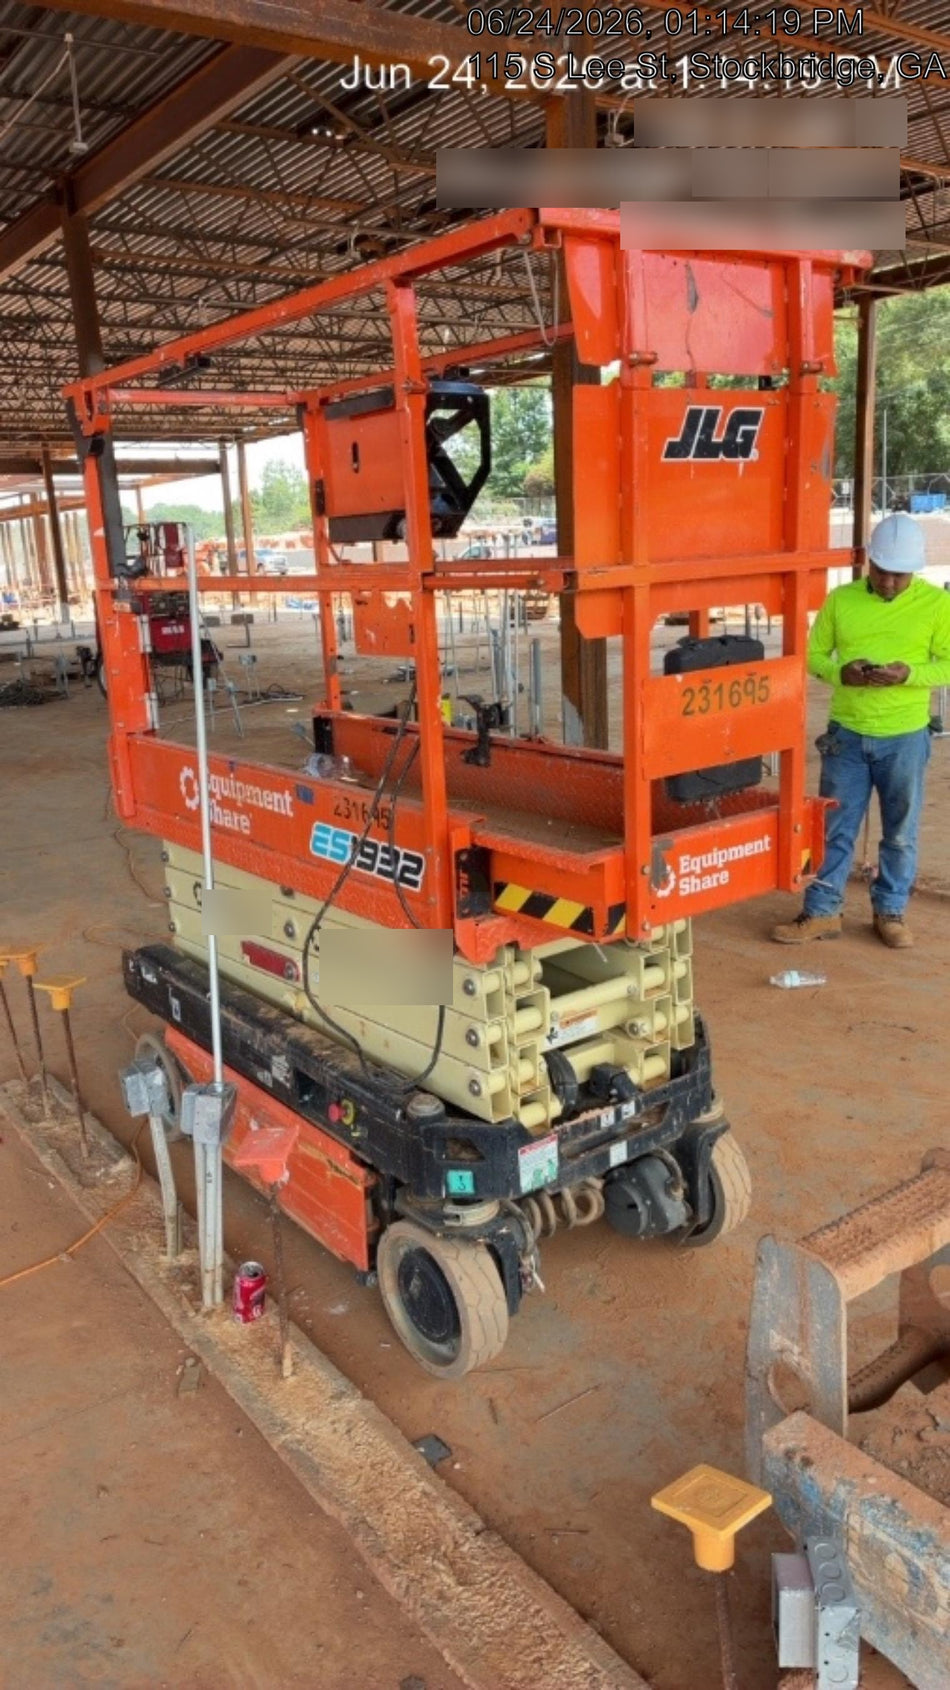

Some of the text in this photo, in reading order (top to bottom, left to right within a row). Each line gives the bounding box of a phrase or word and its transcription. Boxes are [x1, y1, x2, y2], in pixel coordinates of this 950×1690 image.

[661, 405, 765, 462] JLG
[681, 675, 770, 716] 231695
[208, 772, 294, 818] quipment
[209, 797, 251, 836] hare
[678, 834, 772, 875] Equipment
[678, 869, 730, 897] Share
